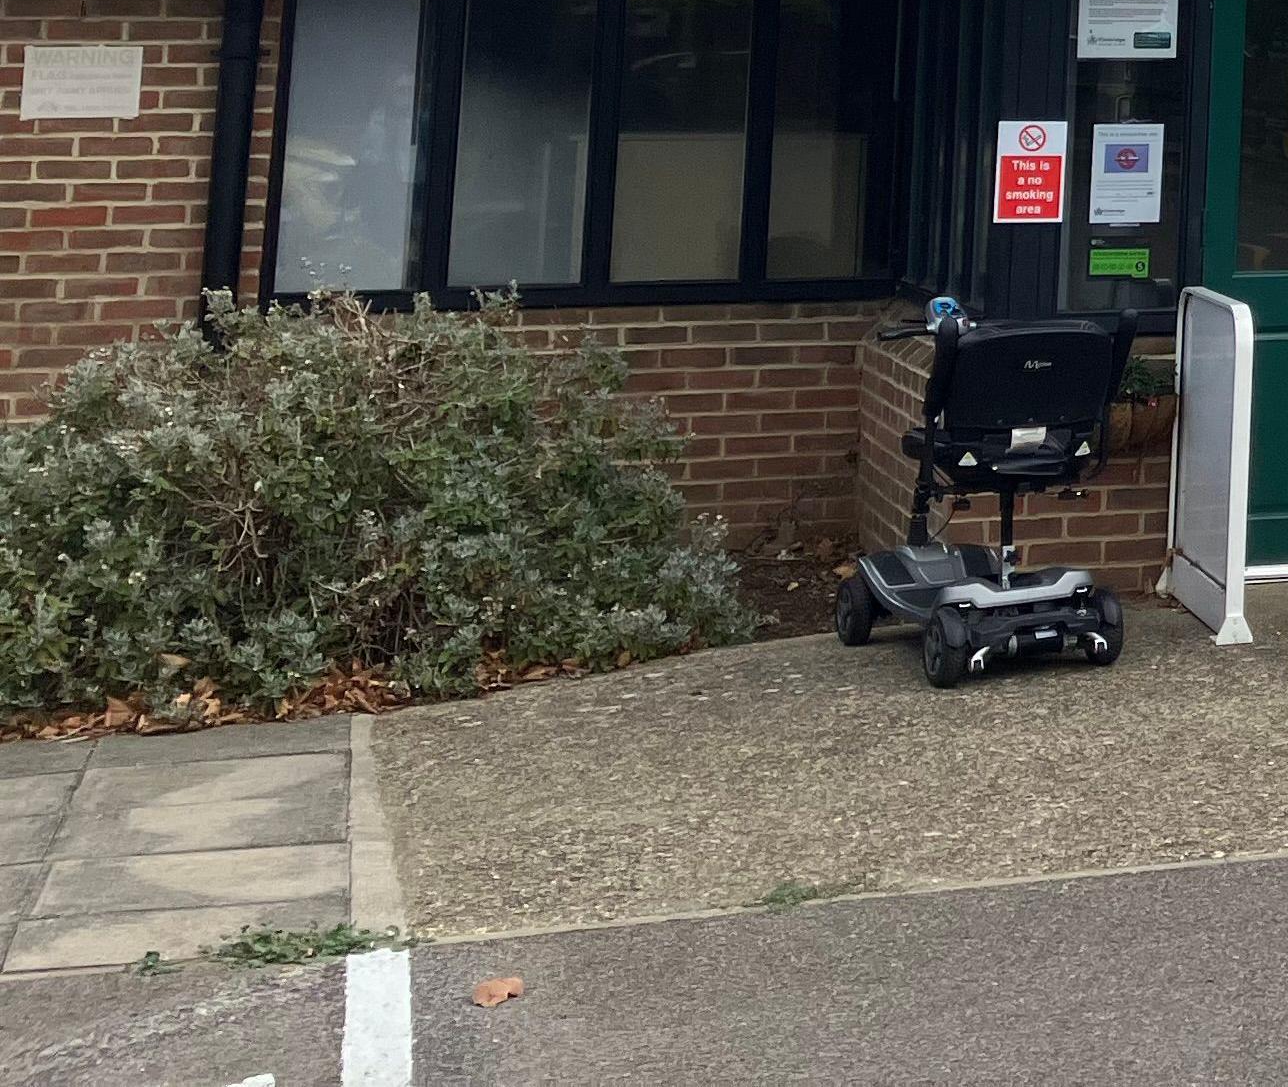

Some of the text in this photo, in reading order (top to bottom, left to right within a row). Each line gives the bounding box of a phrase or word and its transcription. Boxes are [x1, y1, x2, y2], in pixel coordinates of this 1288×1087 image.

[31, 48, 135, 66] WARNING
[1011, 160, 1051, 171] This is
[1017, 176, 1043, 186] a no
[1005, 189, 1054, 203] smoking
[1015, 205, 1041, 215] area
